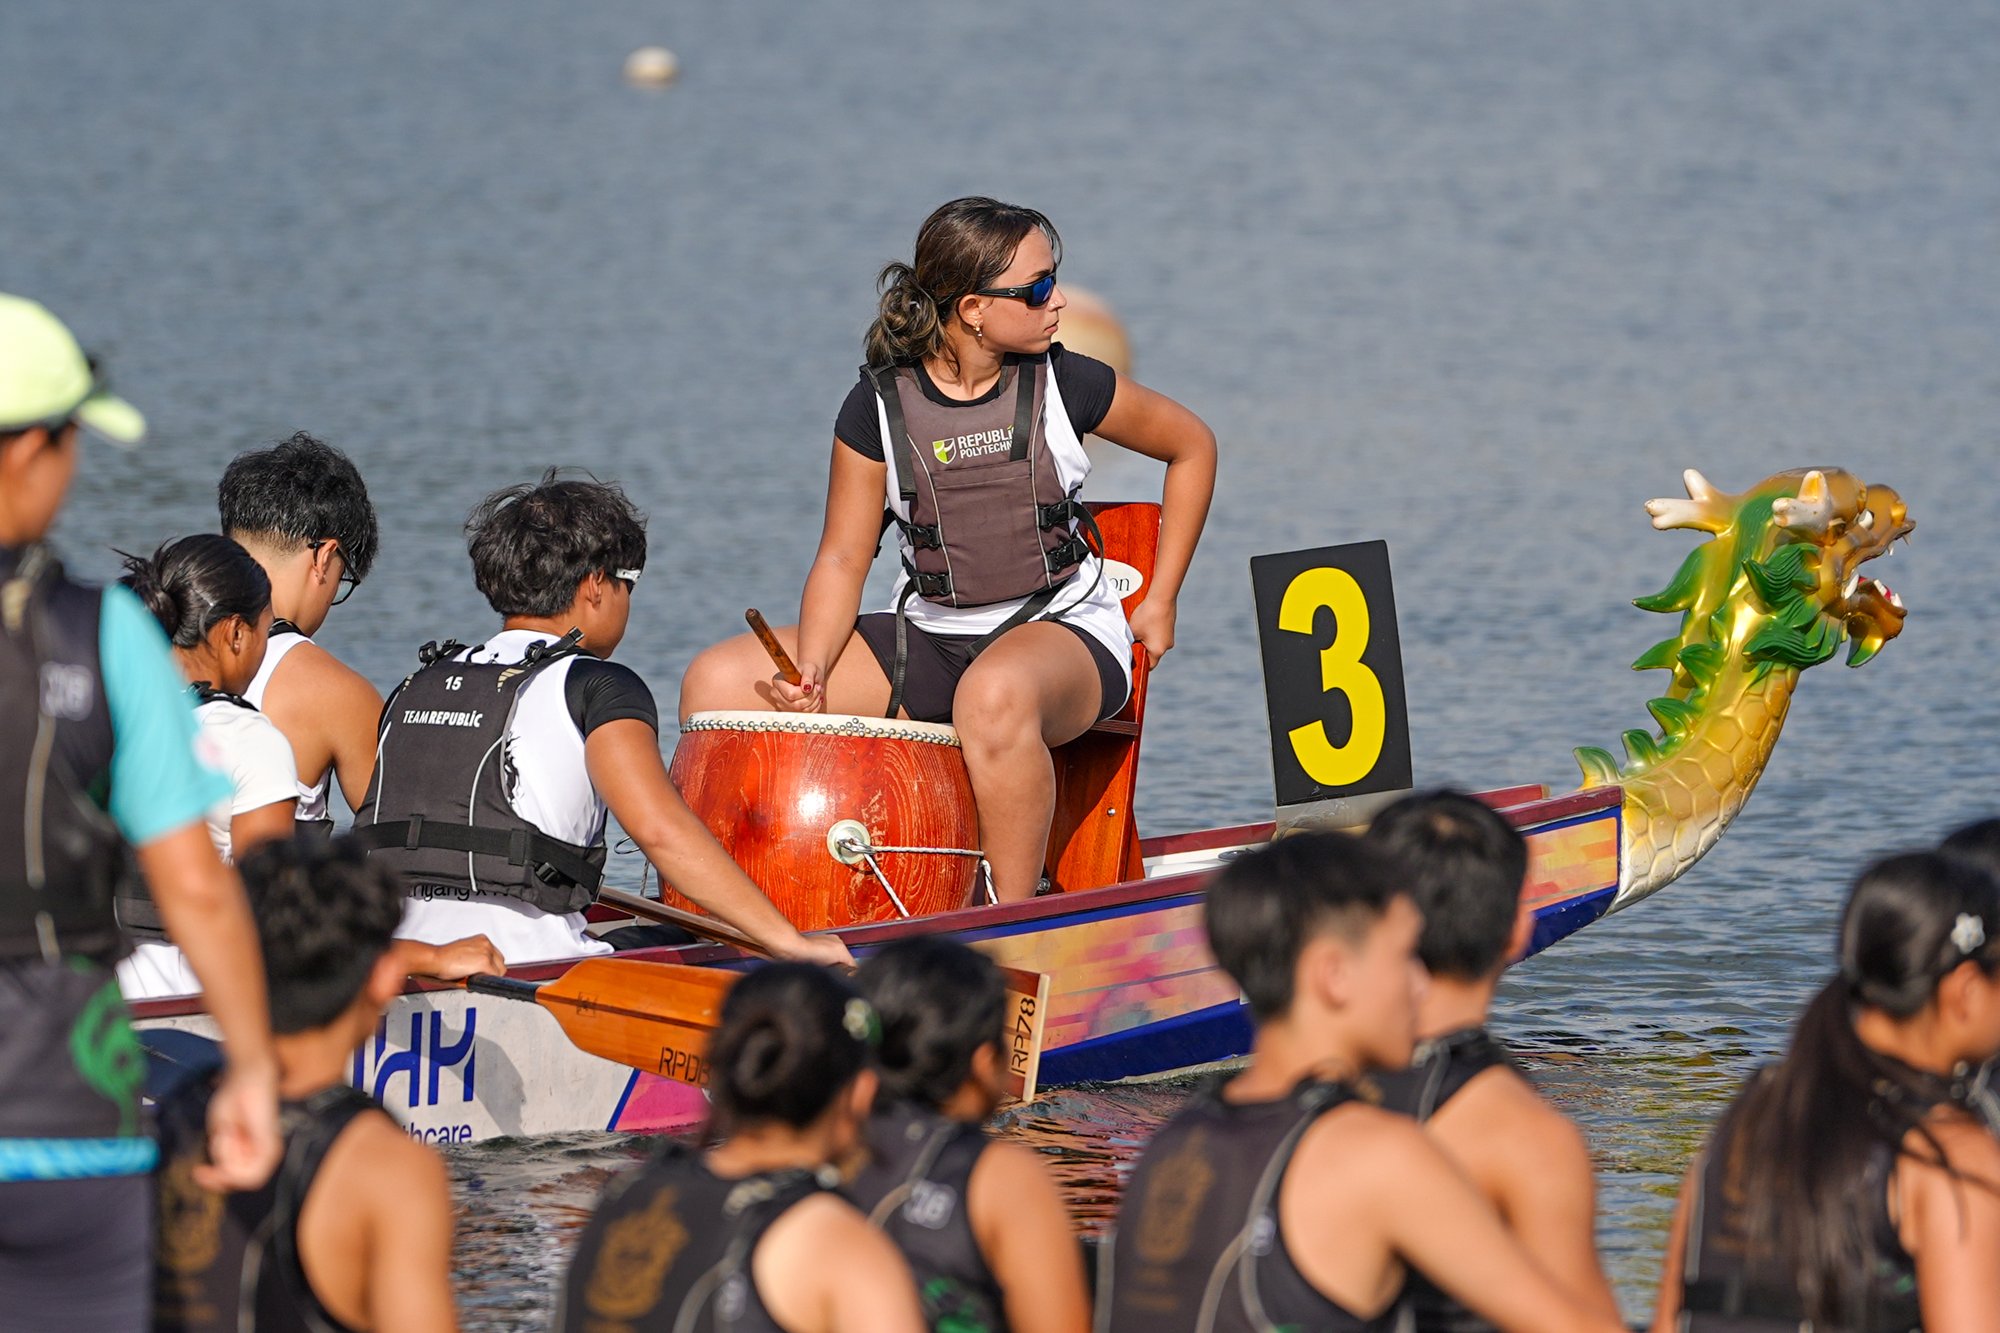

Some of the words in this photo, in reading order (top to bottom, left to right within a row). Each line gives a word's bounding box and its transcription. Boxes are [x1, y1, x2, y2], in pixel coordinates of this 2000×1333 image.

[960, 440, 1012, 459] POLYTECHN
[445, 675, 463, 691] 15
[1278, 566, 1386, 787] 3
